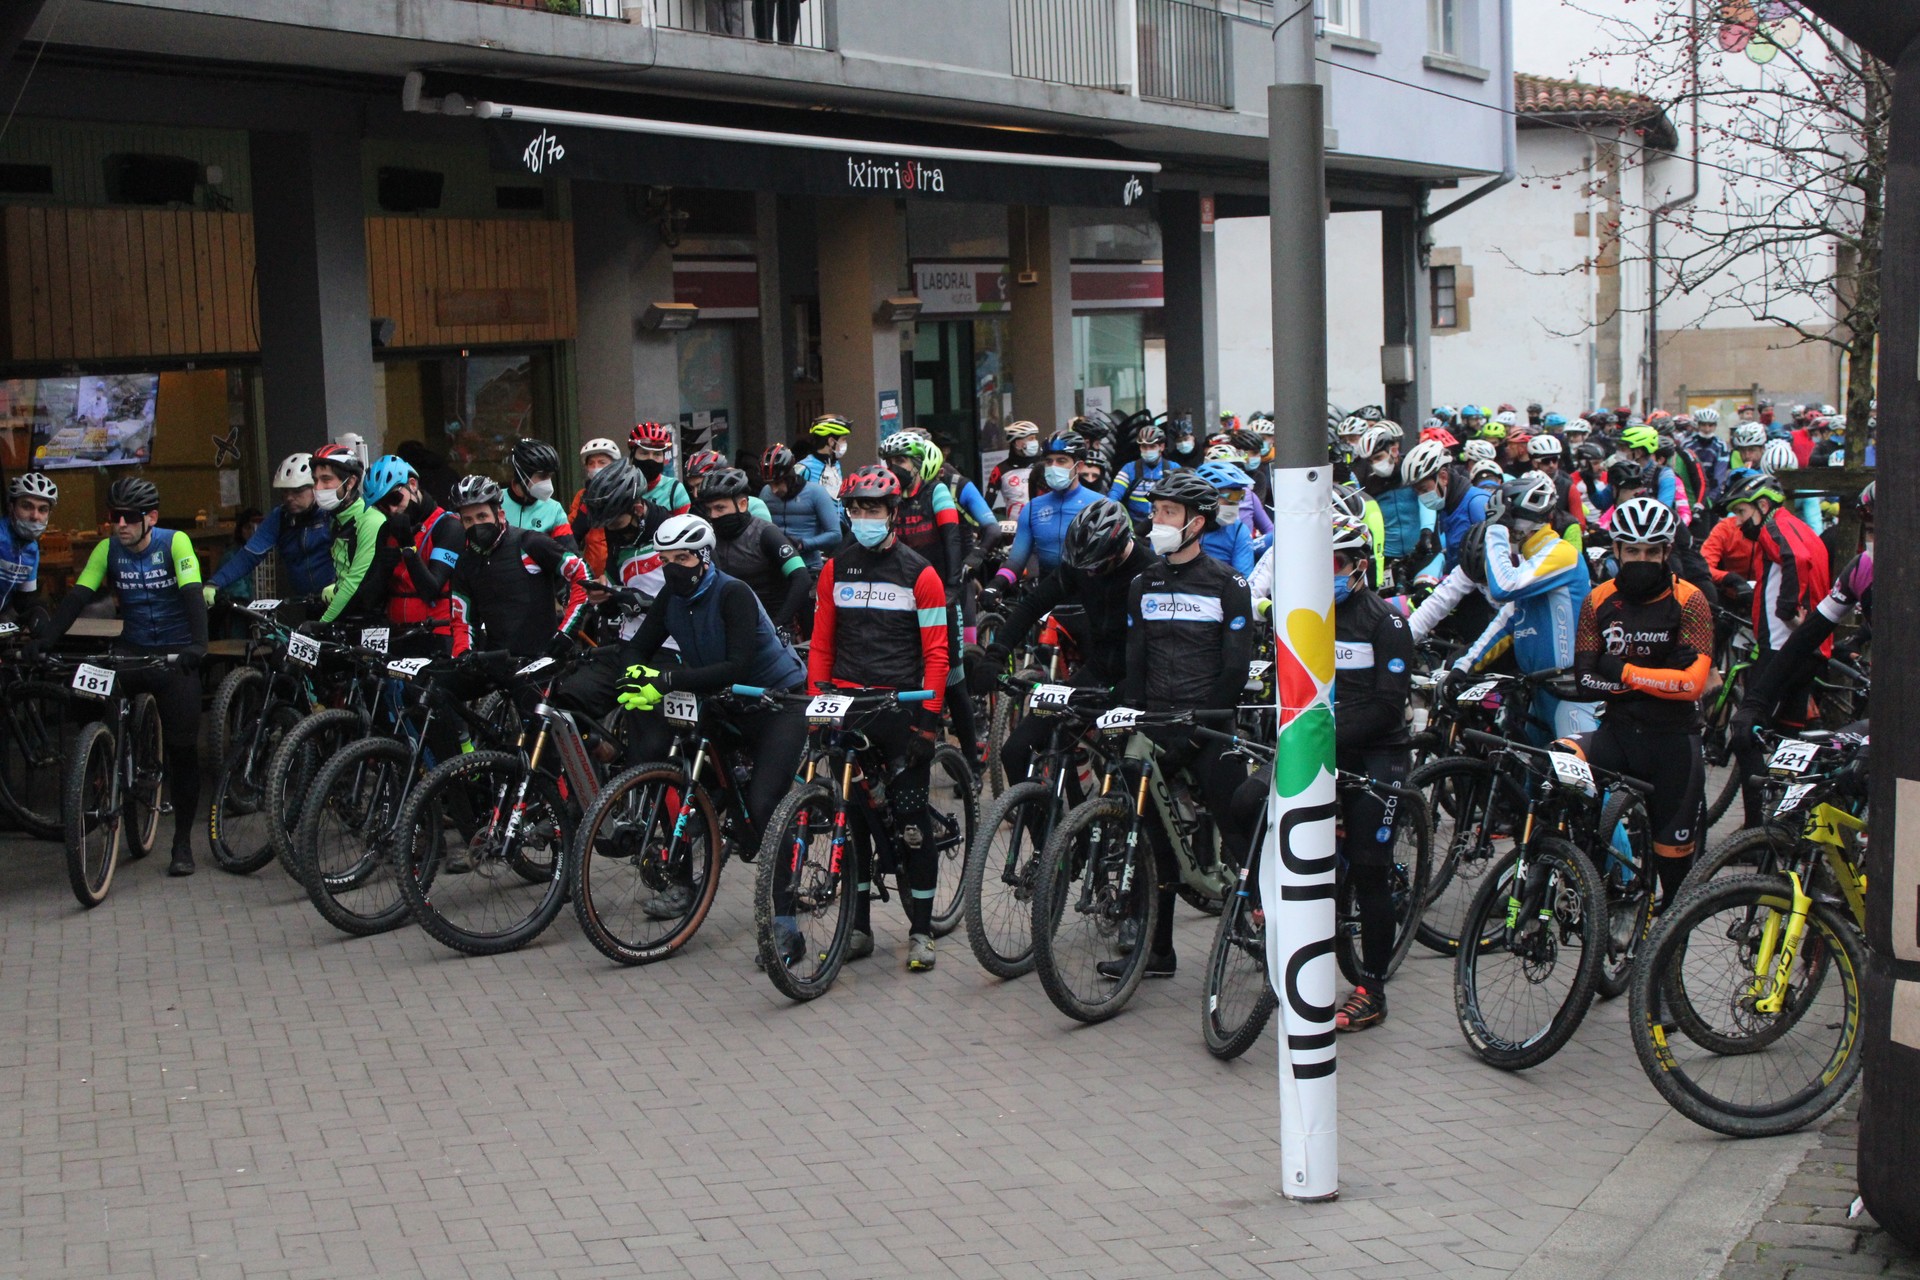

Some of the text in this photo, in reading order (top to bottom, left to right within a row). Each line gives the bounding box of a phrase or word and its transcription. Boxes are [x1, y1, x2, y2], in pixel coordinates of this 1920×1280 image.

[523, 128, 565, 173] 18/70
[921, 272, 972, 290] LABORAL
[855, 588, 897, 602] azcue
[1158, 601, 1201, 613] azcue
[290, 642, 318, 662] 353
[77, 674, 109, 693] 181
[666, 700, 695, 717] 317
[814, 701, 842, 714] 35
[1773, 749, 1807, 769] 421
[450, 760, 492, 777] MAXXIS
[1556, 760, 1590, 779] 285
[324, 873, 356, 885] MAXXIS
